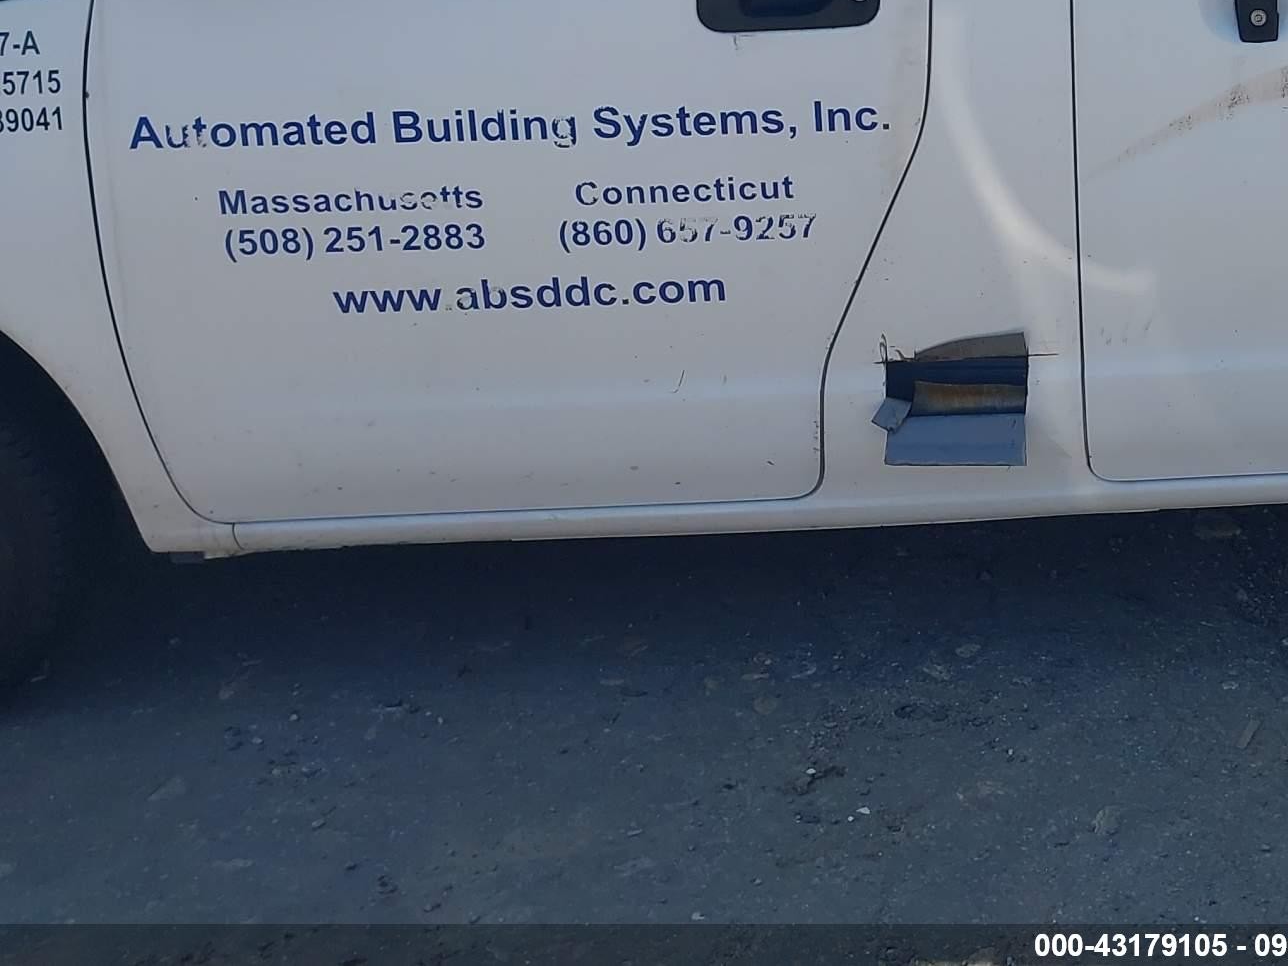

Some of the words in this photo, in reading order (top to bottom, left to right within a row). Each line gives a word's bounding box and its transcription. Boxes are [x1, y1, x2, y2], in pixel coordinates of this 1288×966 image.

[130, 112, 376, 149] Automated
[393, 109, 576, 148] Building
[594, 107, 796, 144] Systems,
[814, 101, 889, 131] Inc.
[219, 186, 482, 214] Massachusetts
[576, 177, 793, 205] Connecticut
[226, 228, 313, 262] (508)
[324, 224, 484, 252] 251-2883
[560, 219, 646, 253] (860)
[333, 277, 725, 313] wwwabsddc.com
